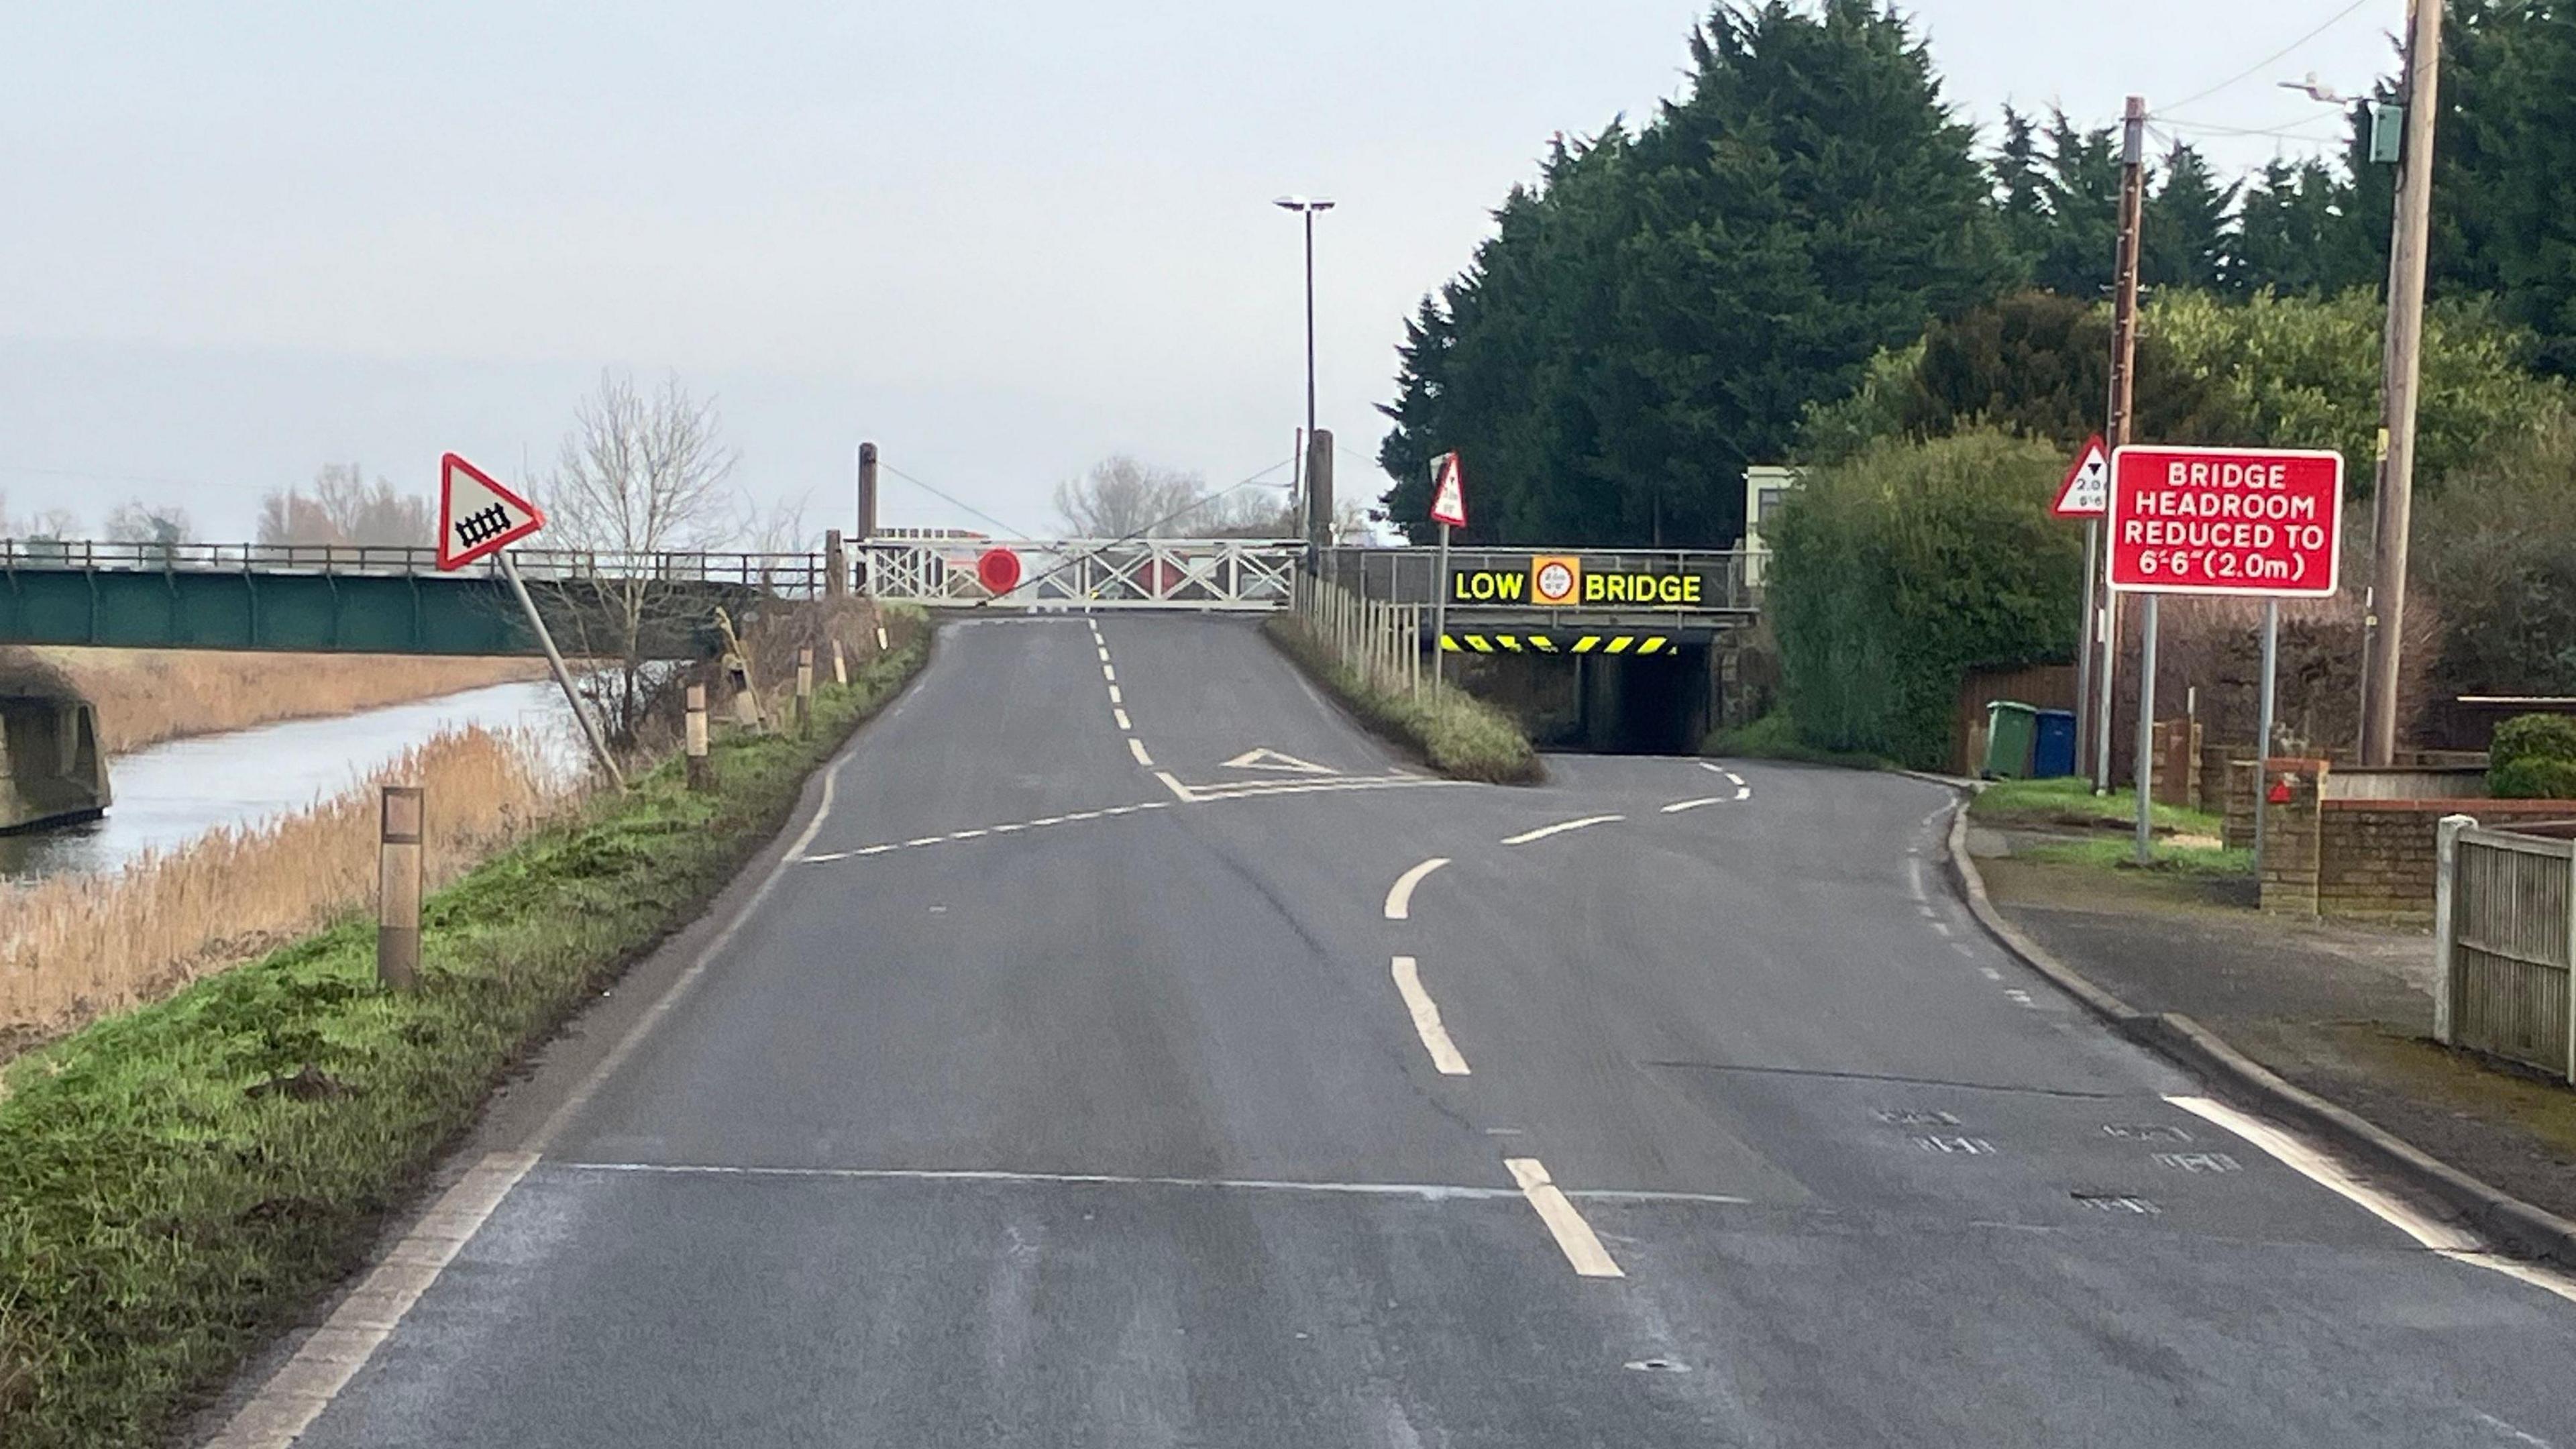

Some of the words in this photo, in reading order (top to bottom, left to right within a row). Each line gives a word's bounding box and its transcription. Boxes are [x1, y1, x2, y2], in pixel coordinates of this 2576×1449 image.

[2167, 461, 2286, 490] BRIDGE
[2135, 490, 2316, 521] HEADROOM
[2125, 519, 2275, 549] REDUCED
[2284, 524, 2324, 551] TO
[1455, 572, 1525, 600] LOW
[1585, 573, 1702, 602] BRIDGE
